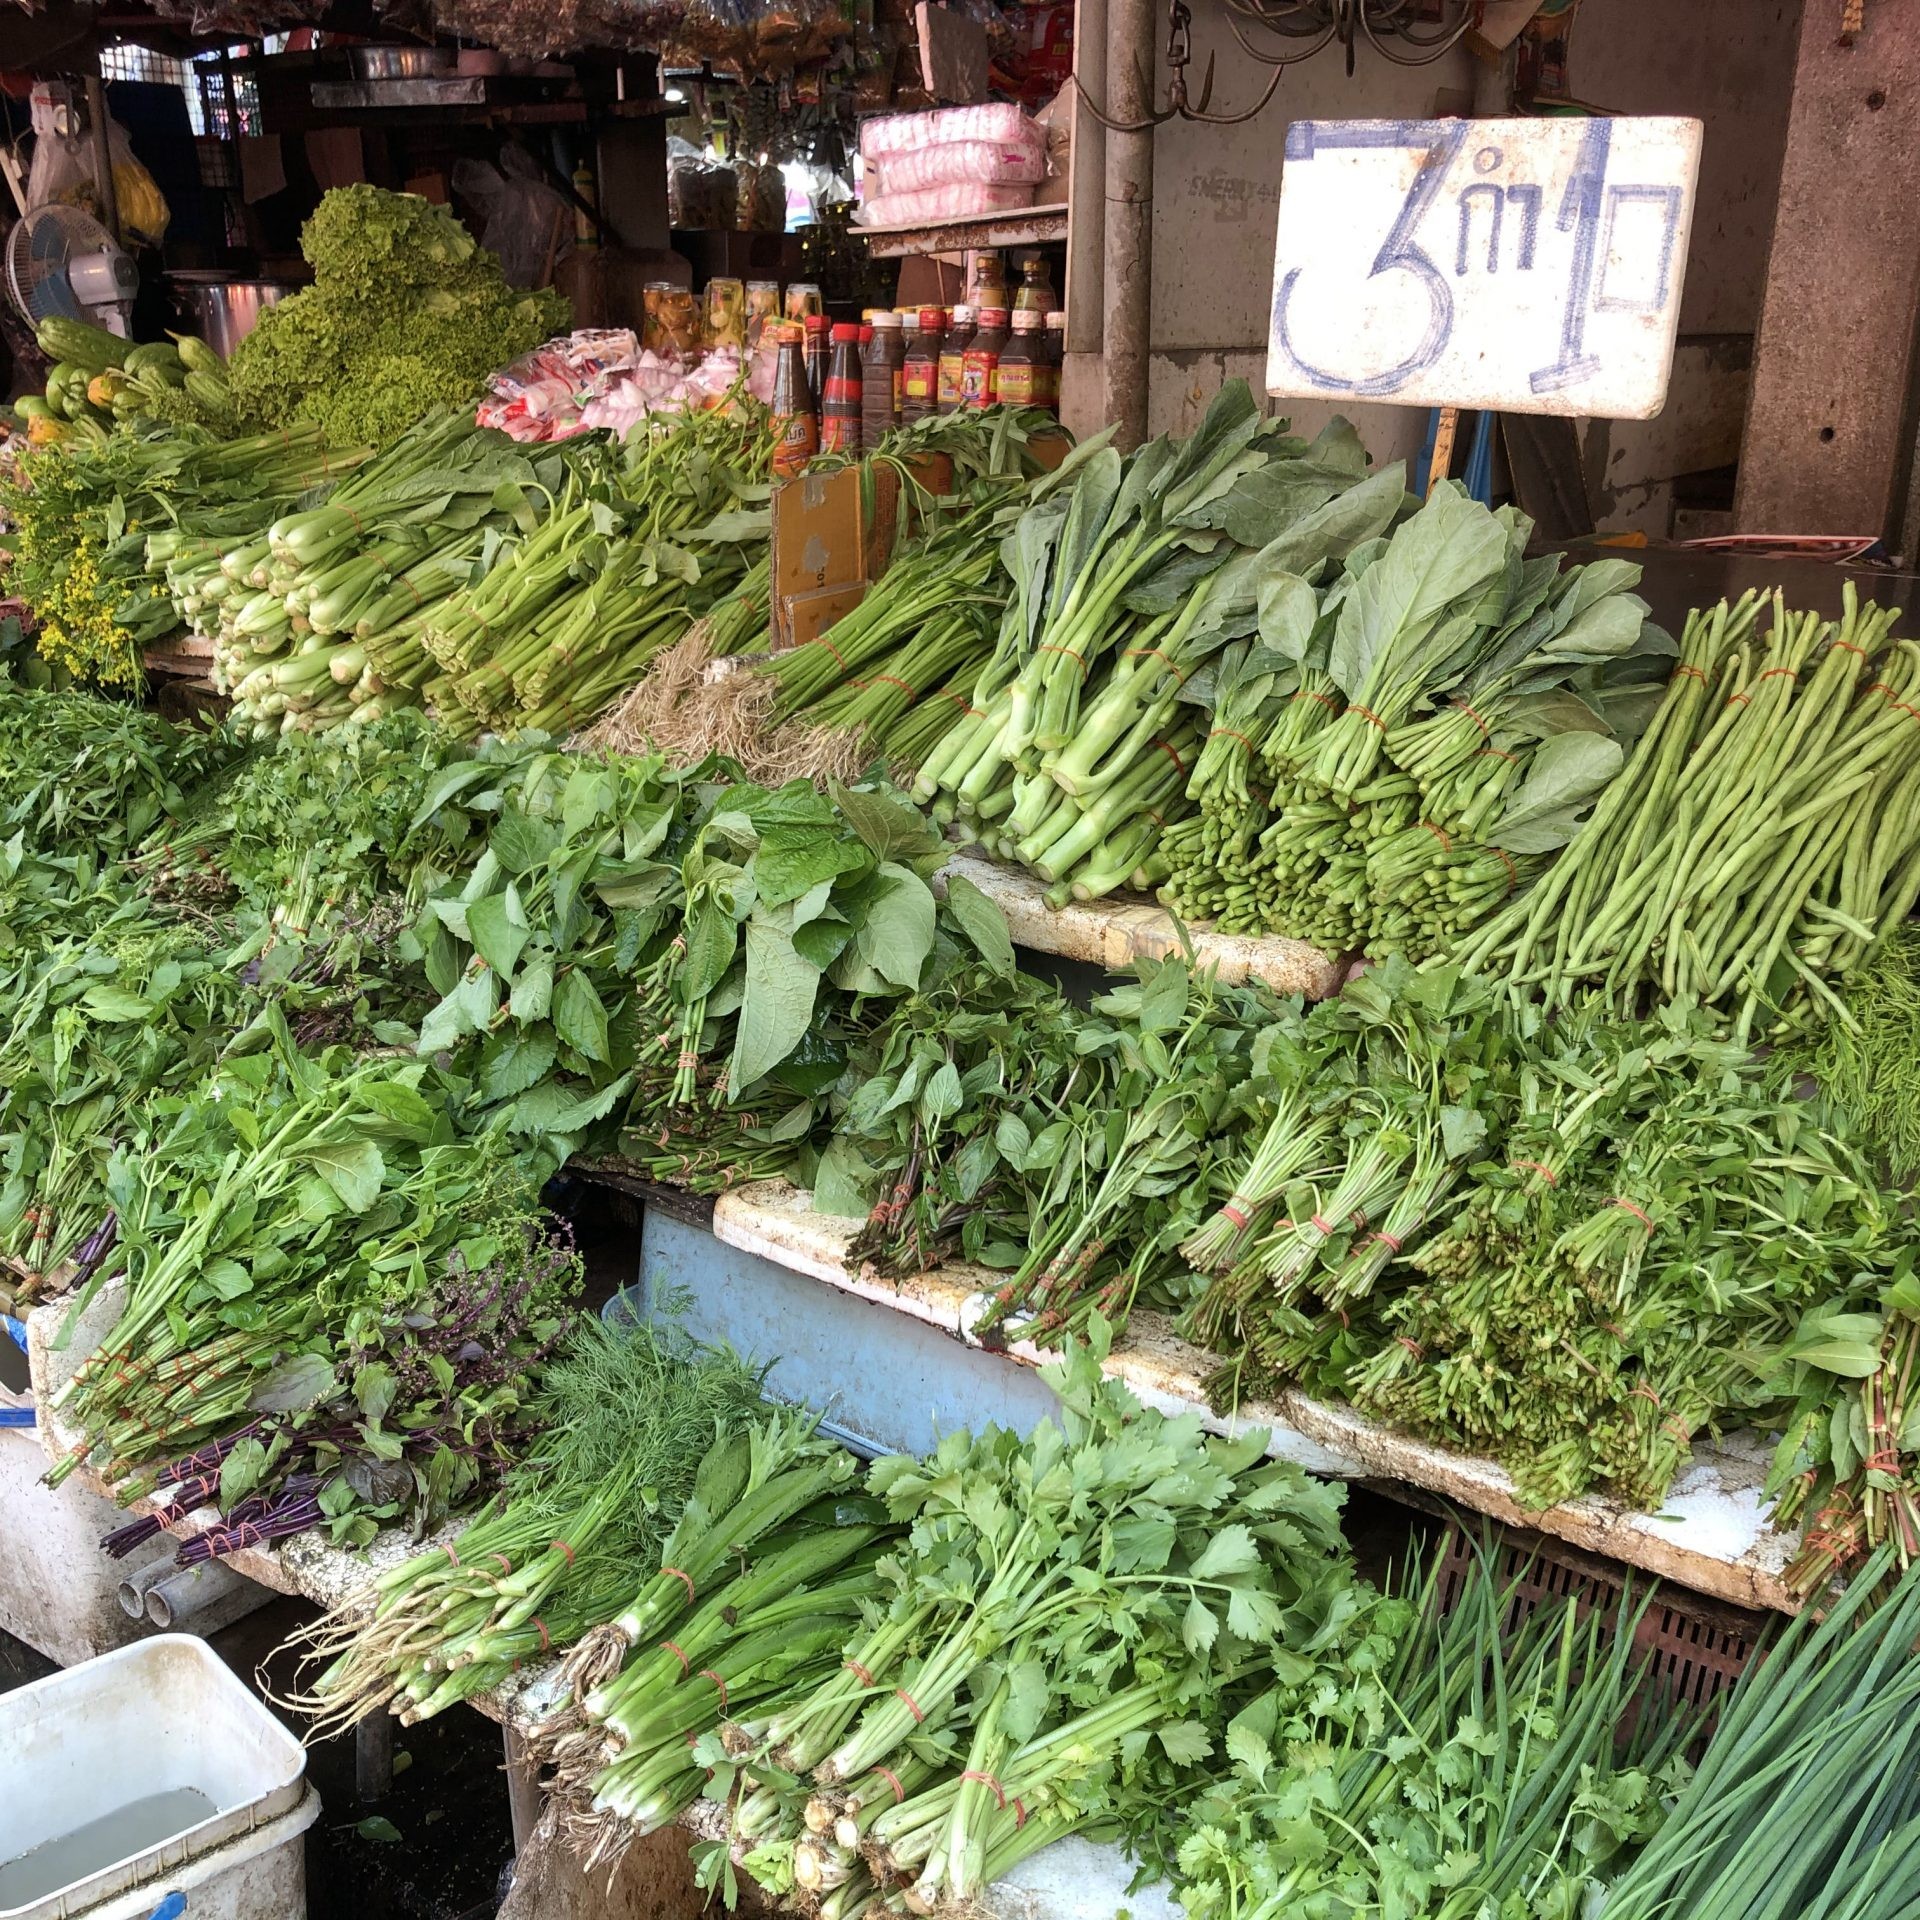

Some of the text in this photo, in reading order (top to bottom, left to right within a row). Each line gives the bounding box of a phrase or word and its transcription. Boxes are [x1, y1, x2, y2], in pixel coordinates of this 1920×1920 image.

[1273, 118, 1683, 396] 3 กำ 10
